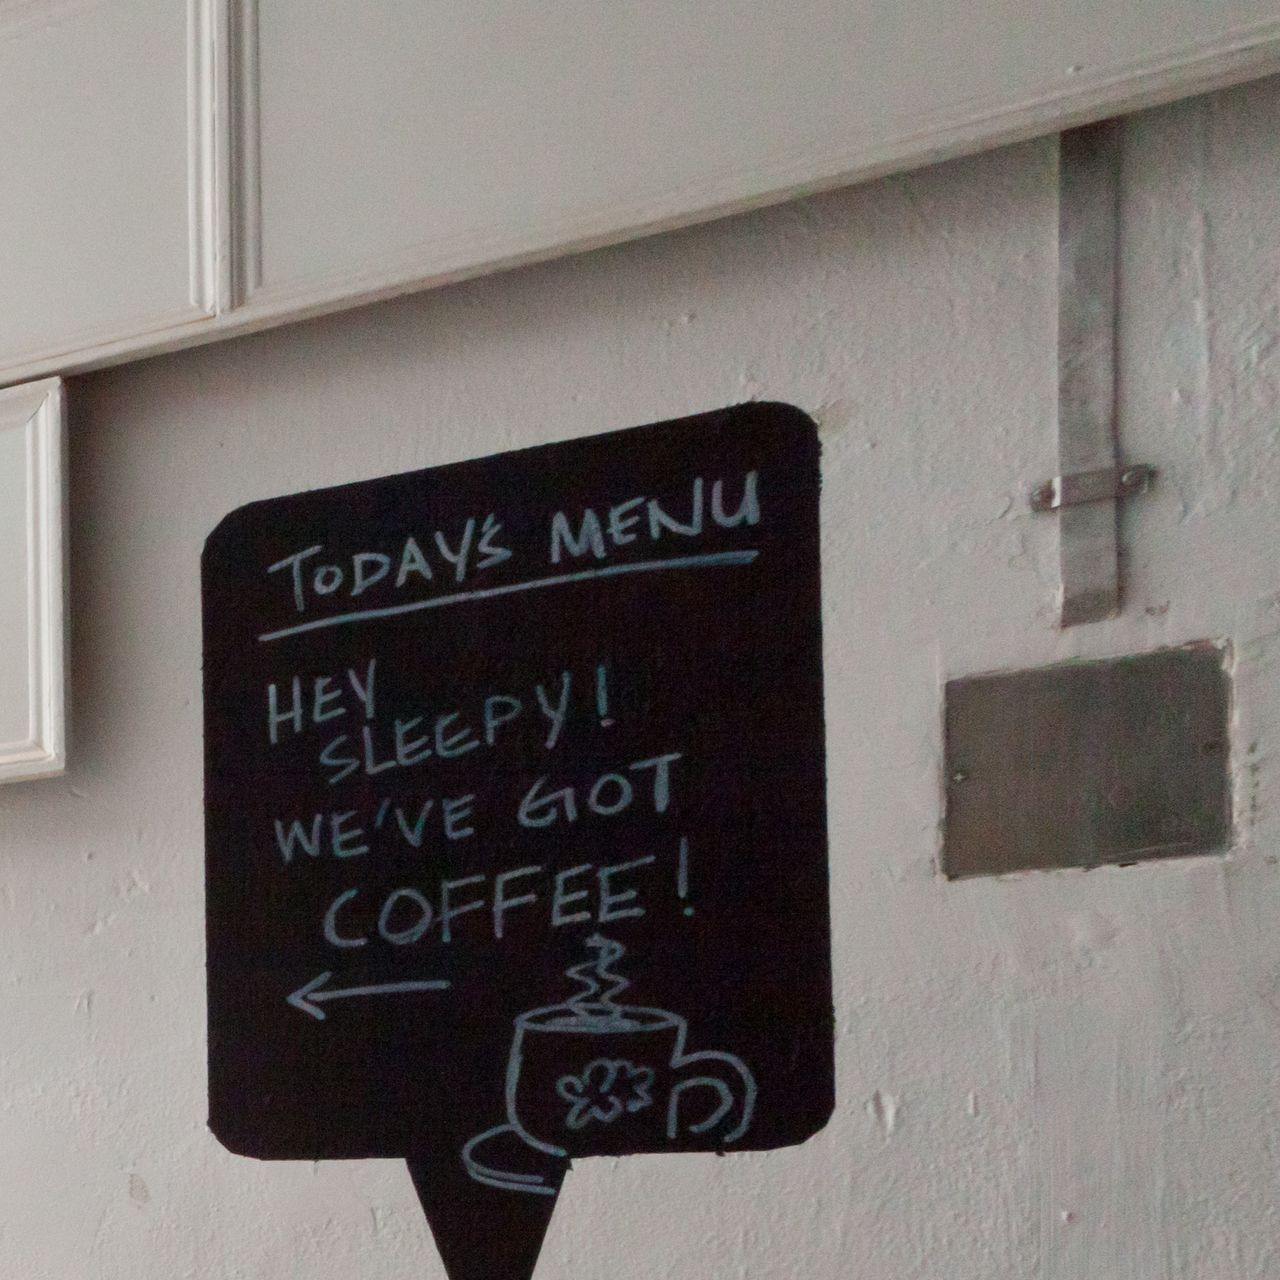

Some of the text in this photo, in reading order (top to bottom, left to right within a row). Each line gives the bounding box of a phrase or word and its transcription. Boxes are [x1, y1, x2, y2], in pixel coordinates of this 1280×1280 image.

[550, 469, 762, 566] MENU
[266, 658, 377, 744] HEY
[319, 663, 617, 785] SLEEPY!
[273, 751, 684, 865] WE'VE GOT
